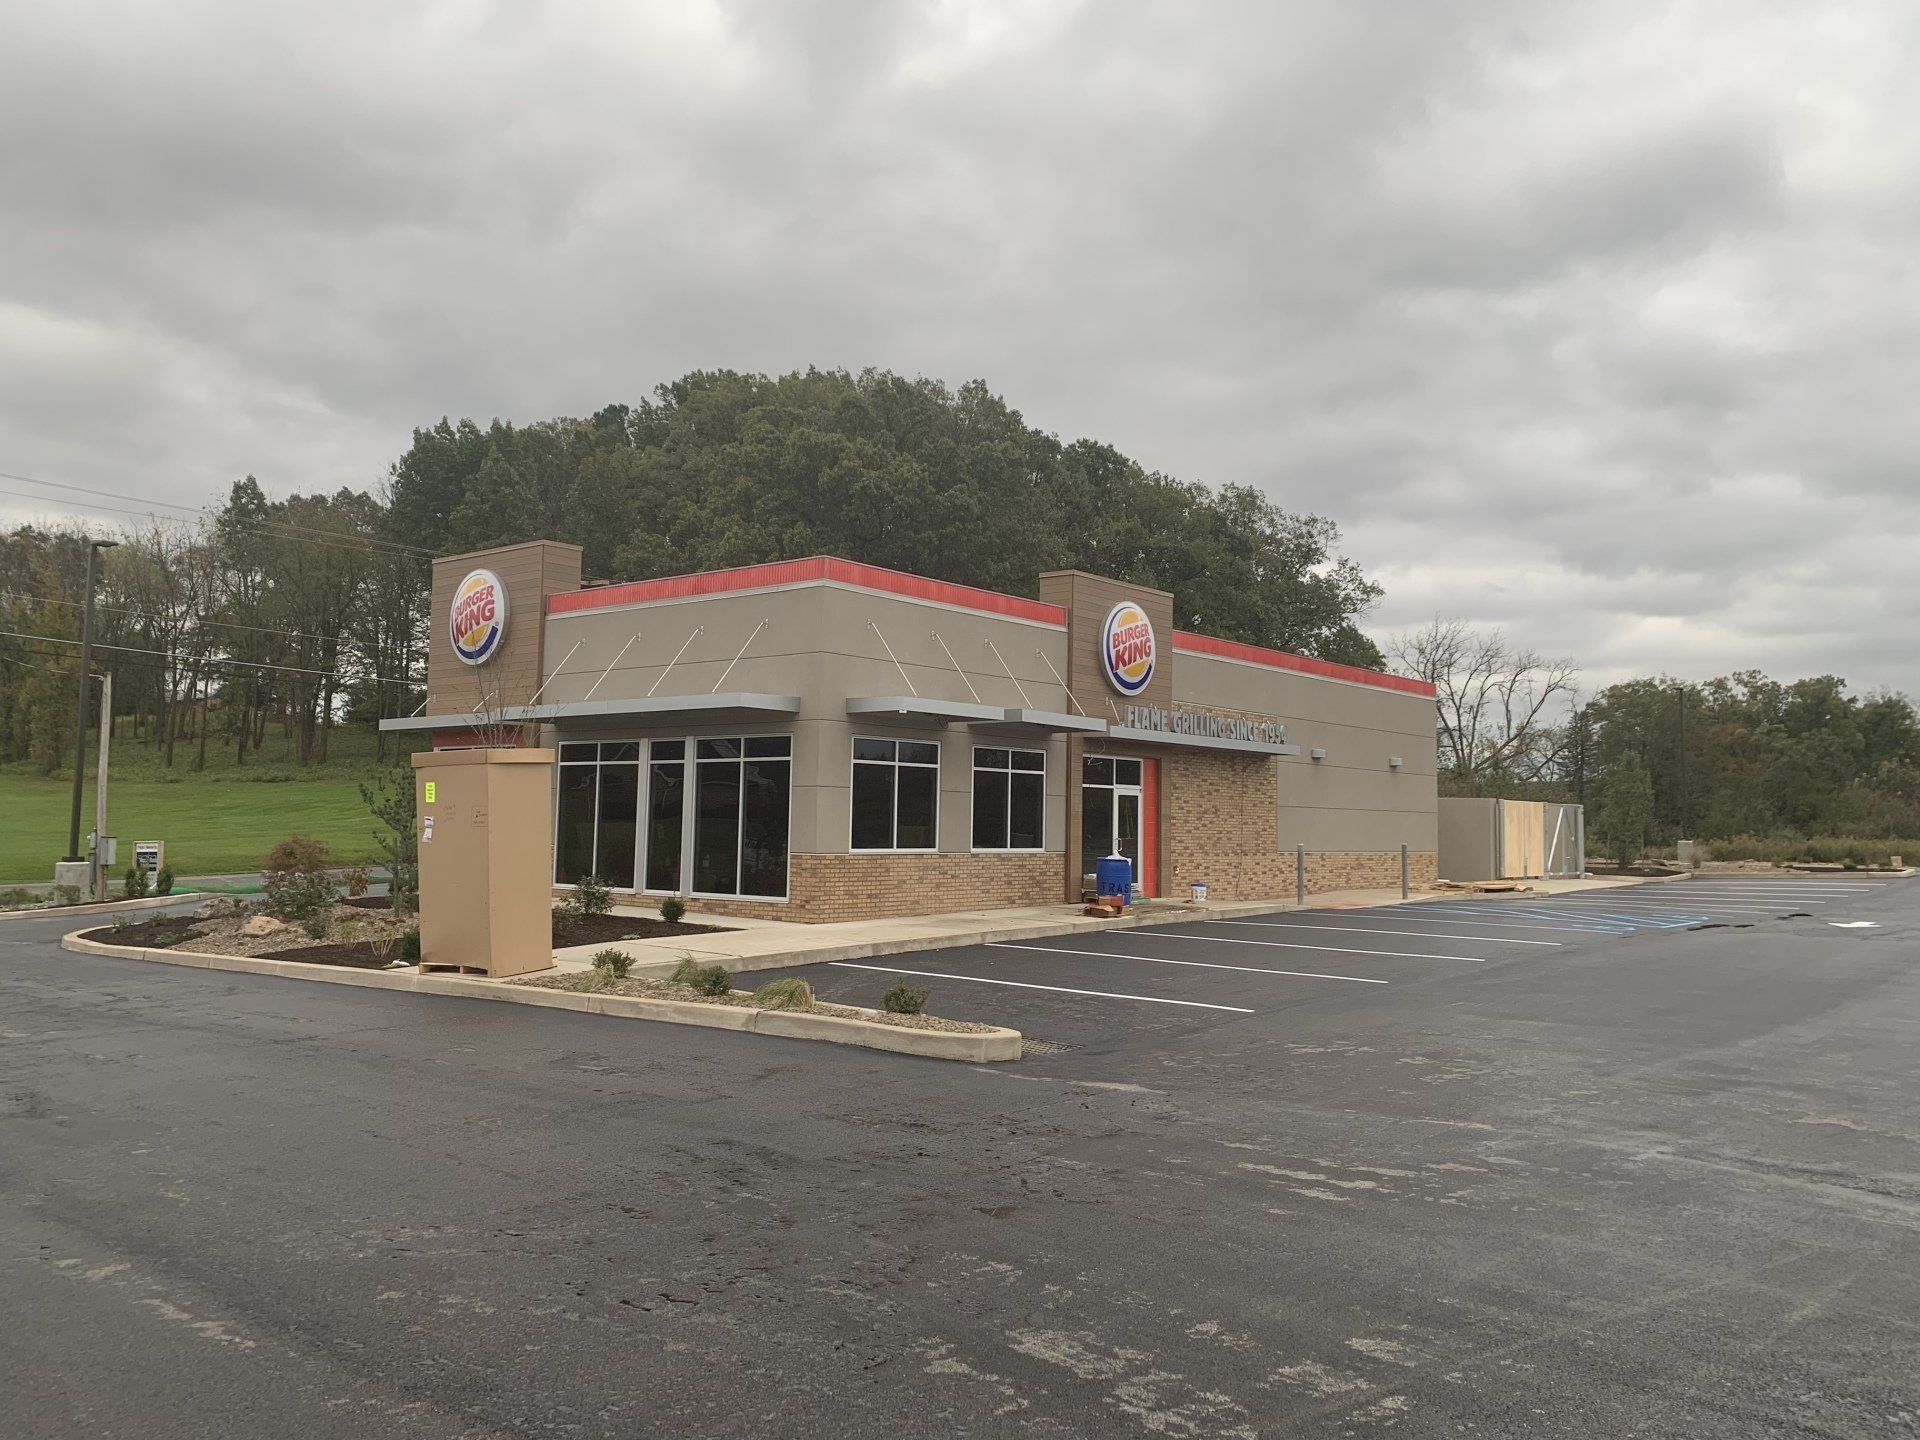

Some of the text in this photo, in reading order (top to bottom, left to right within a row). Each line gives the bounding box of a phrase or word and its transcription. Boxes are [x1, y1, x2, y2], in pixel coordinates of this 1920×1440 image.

[455, 584, 494, 621] BURGER
[455, 598, 495, 645] KING
[1112, 623, 1150, 650] BURGER
[1113, 636, 1152, 673] KING
[1126, 705, 1168, 731] FLAME
[1173, 711, 1226, 738] GRILLING
[1230, 718, 1260, 742] SINCE
[1102, 881, 1131, 894] TRAS
